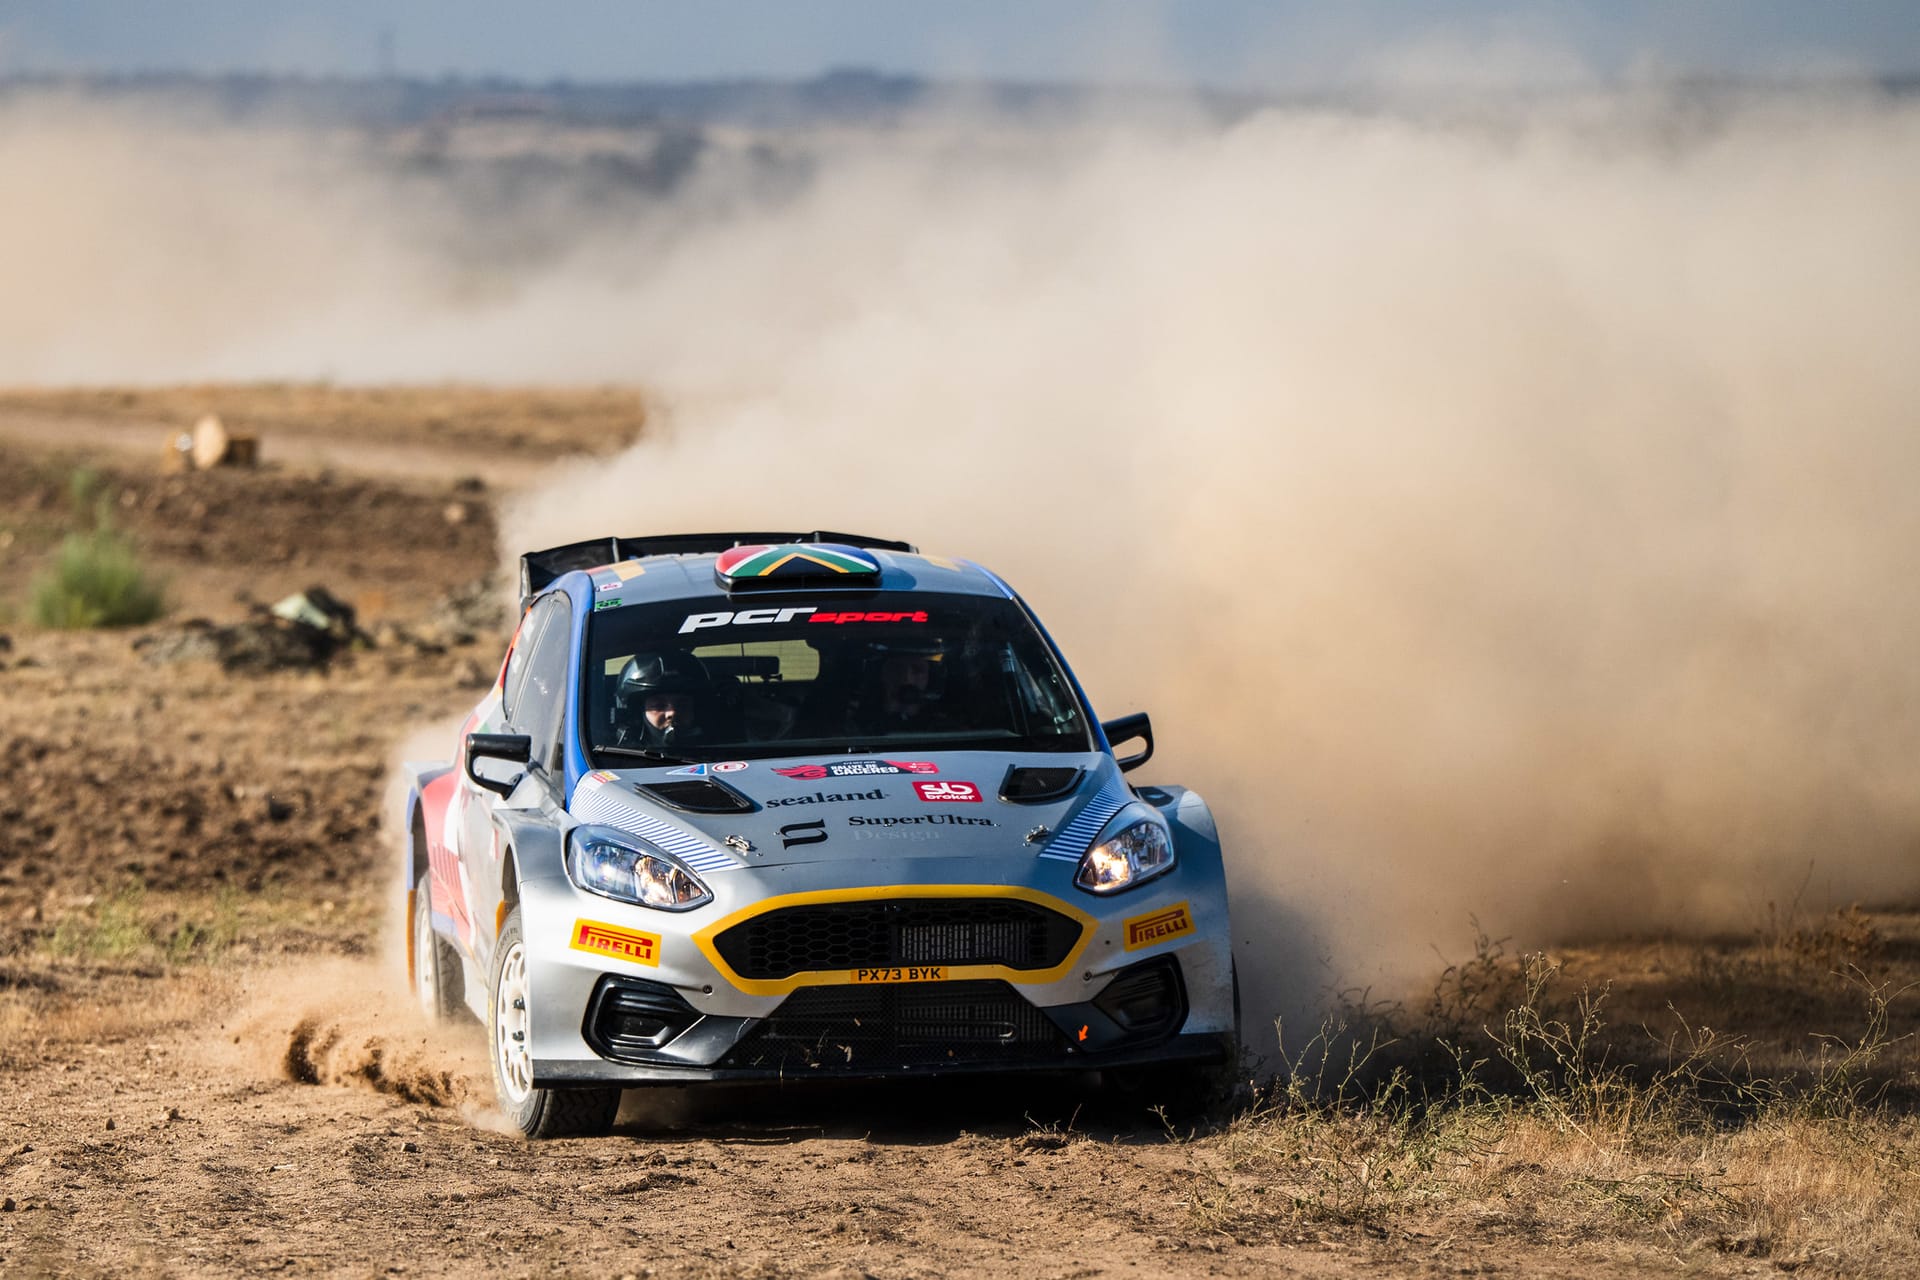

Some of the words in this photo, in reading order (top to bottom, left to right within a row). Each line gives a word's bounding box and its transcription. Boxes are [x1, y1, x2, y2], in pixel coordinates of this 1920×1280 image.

[808, 611, 929, 624] sport
[766, 789, 886, 809] sealand
[924, 791, 975, 800] broker
[848, 814, 994, 828] SuperUltra
[851, 828, 941, 842] Design
[1129, 908, 1188, 945] PIRELLI
[577, 924, 653, 960] PIRELLI
[858, 968, 902, 981] PX73
[909, 967, 941, 980] BYK
